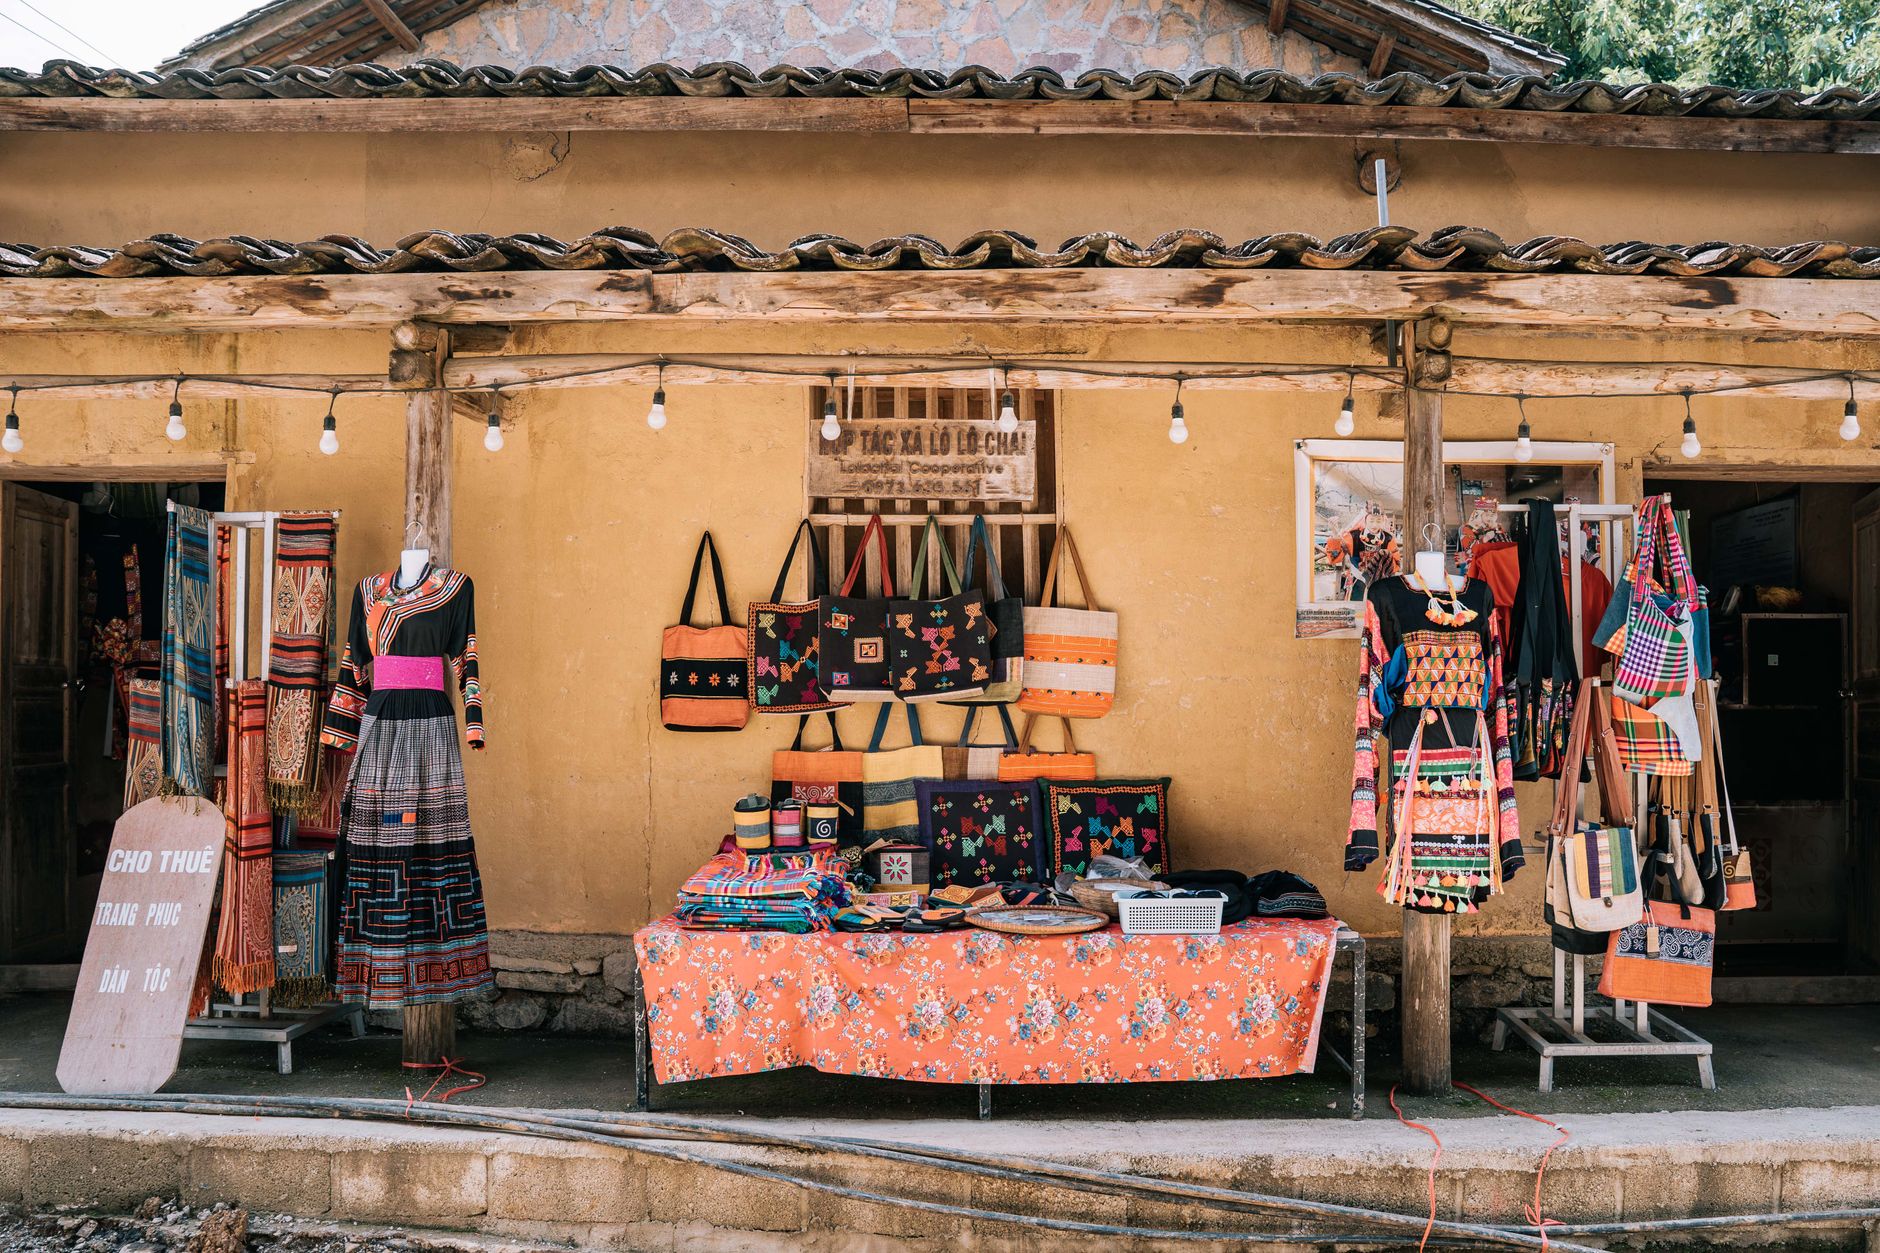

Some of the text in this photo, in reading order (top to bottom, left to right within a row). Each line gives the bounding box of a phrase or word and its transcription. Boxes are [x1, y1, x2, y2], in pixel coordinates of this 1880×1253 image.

[860, 424, 896, 456] TÁC
[957, 424, 978, 456] LÔ
[909, 461, 1004, 477] Cooperative
[108, 845, 215, 873] CHO THUÊ
[96, 902, 182, 929] TRANG PHỤC
[98, 962, 171, 996] DÂN TỘC
